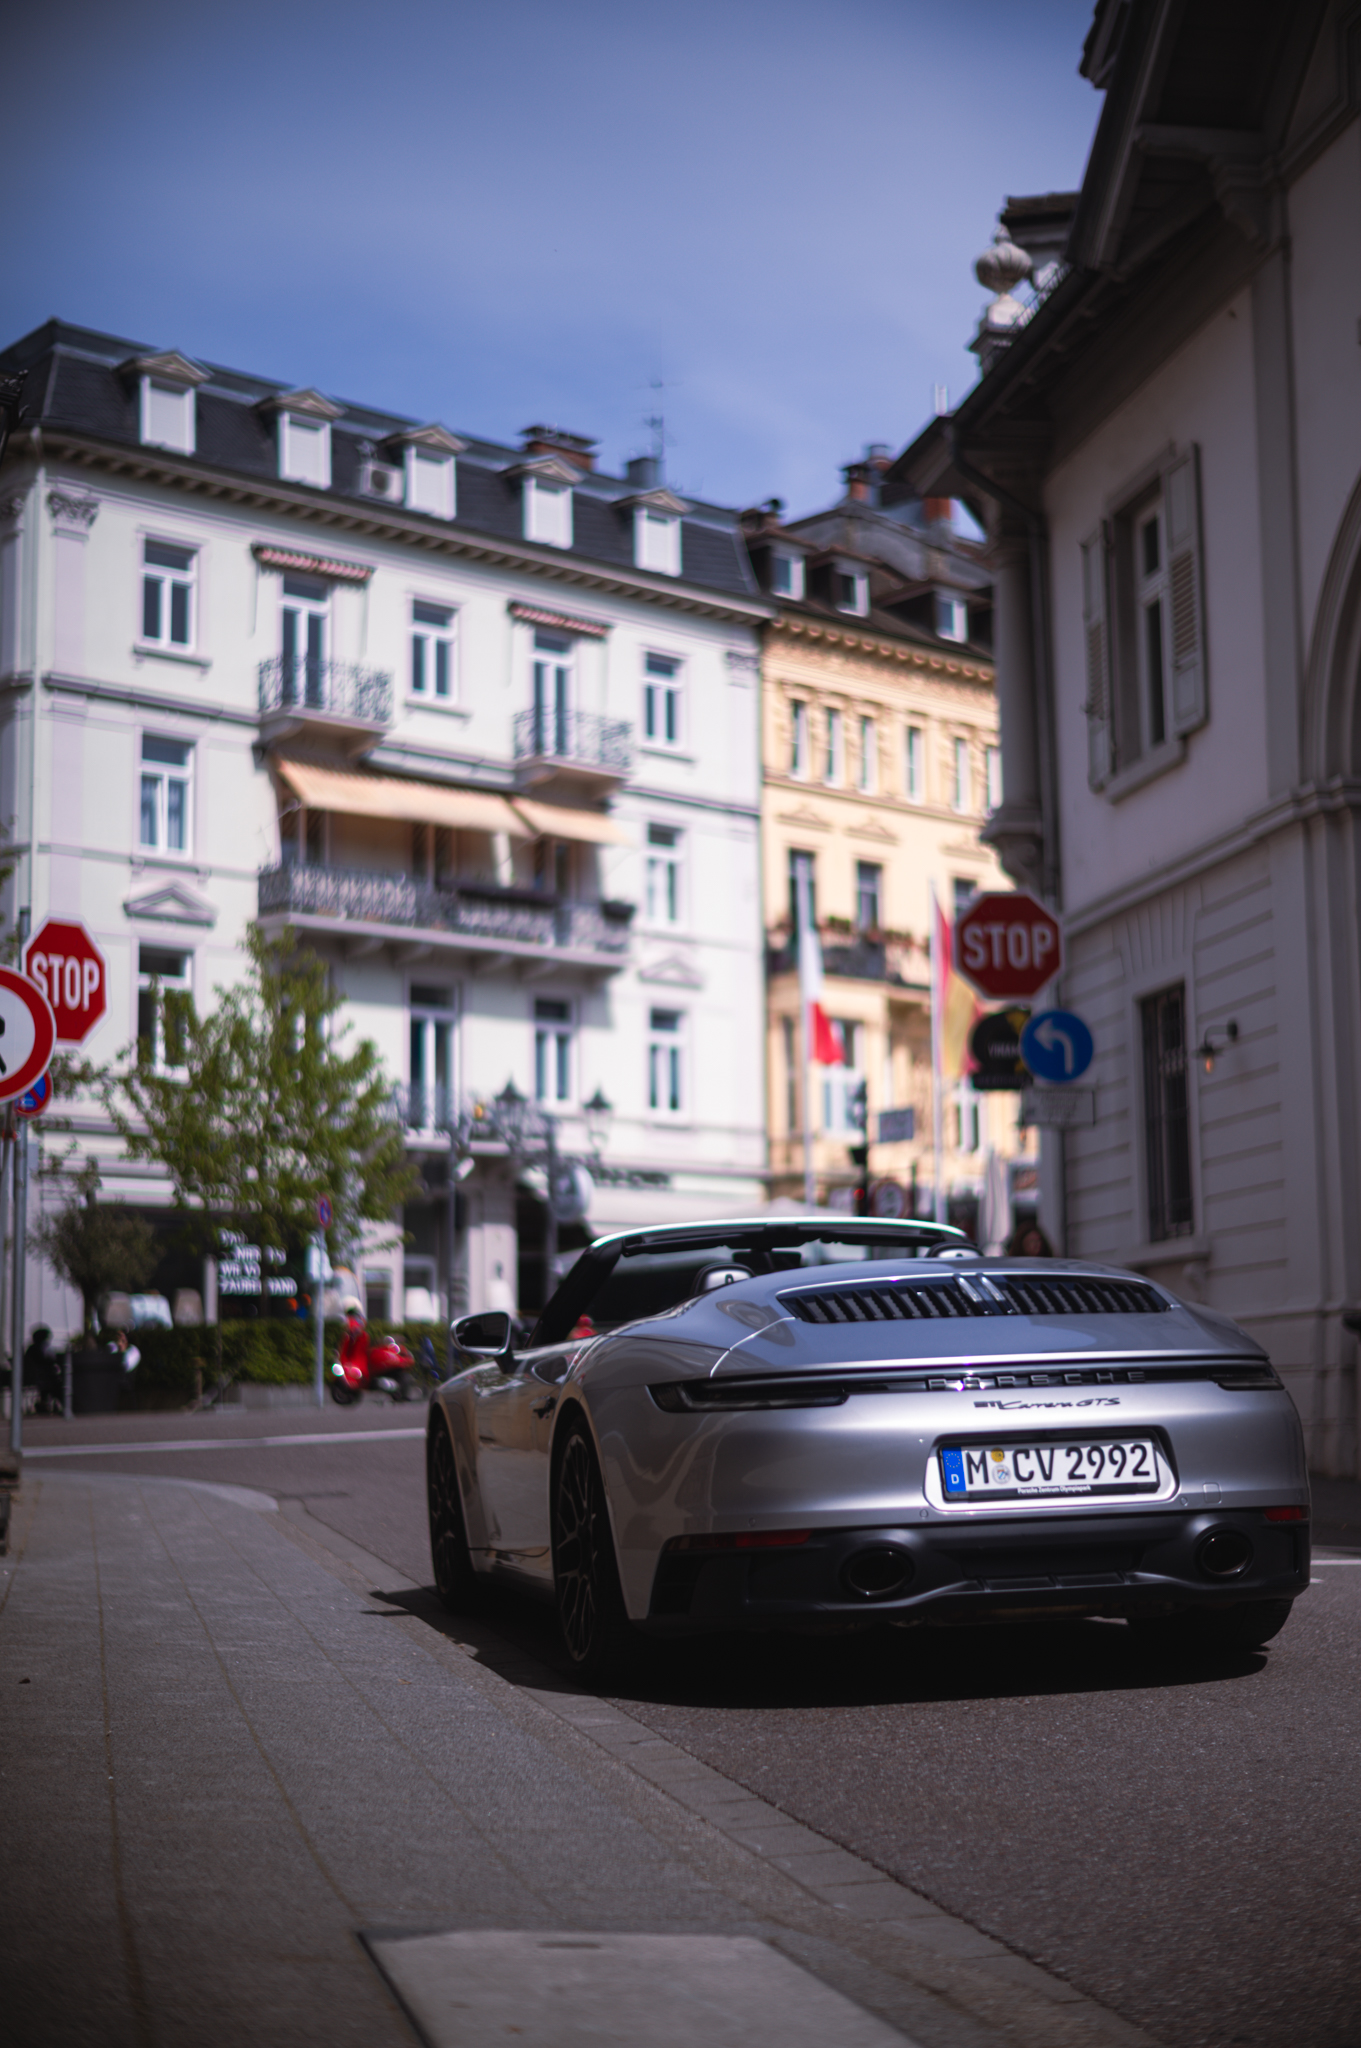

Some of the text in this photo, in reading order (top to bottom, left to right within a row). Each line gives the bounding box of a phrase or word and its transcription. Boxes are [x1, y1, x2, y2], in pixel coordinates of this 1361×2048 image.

[963, 923, 1052, 970] STOP
[30, 950, 100, 1012] STOP
[927, 1371, 1146, 1390] PORSCHE
[1000, 1399, 1073, 1410] Carrera
[1076, 1397, 1121, 1407] GTS
[965, 1444, 1150, 1484] M CV 2992
[951, 1473, 960, 1484] D
[1017, 1486, 1038, 1495] Porsche
[1038, 1486, 1059, 1494] Zentrum
